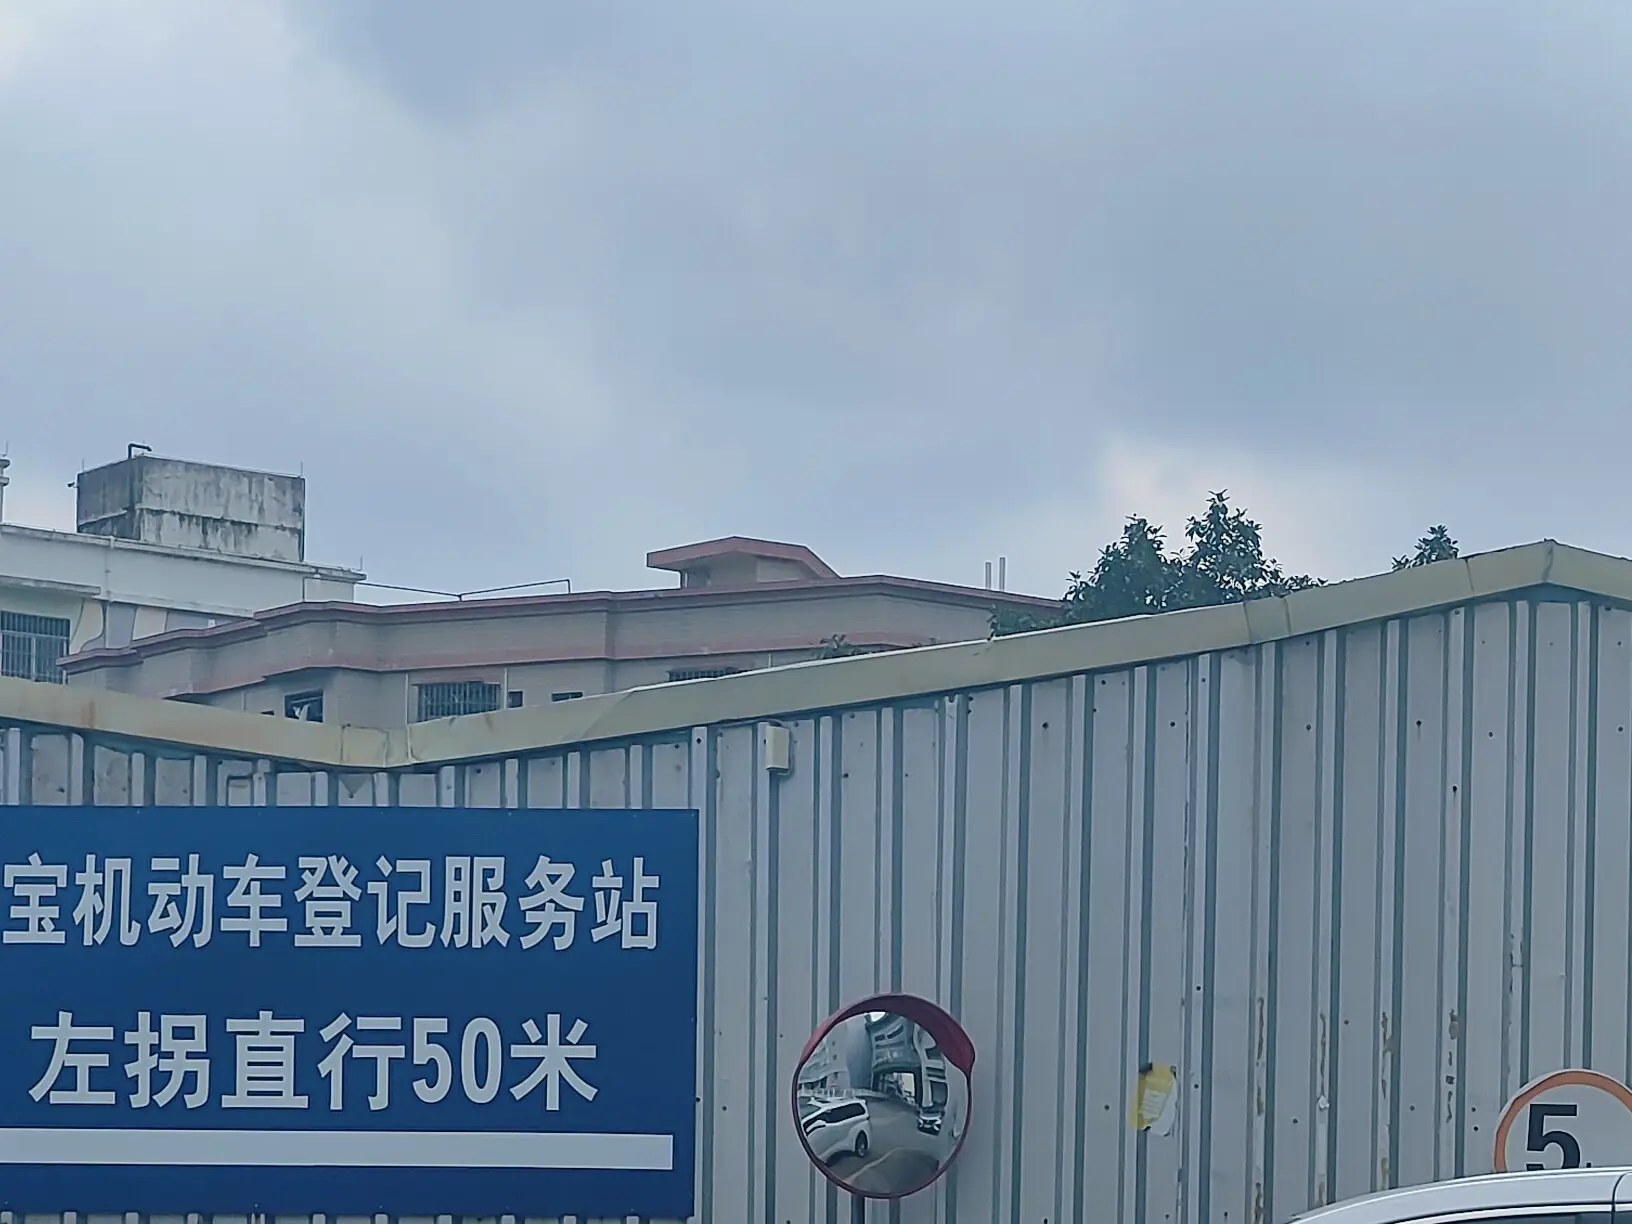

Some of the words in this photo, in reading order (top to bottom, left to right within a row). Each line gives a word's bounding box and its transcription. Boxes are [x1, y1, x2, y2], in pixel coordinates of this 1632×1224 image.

[2, 852, 662, 951] 宝机动车登记服务站
[28, 1010, 599, 1112] 左拐直行50米
